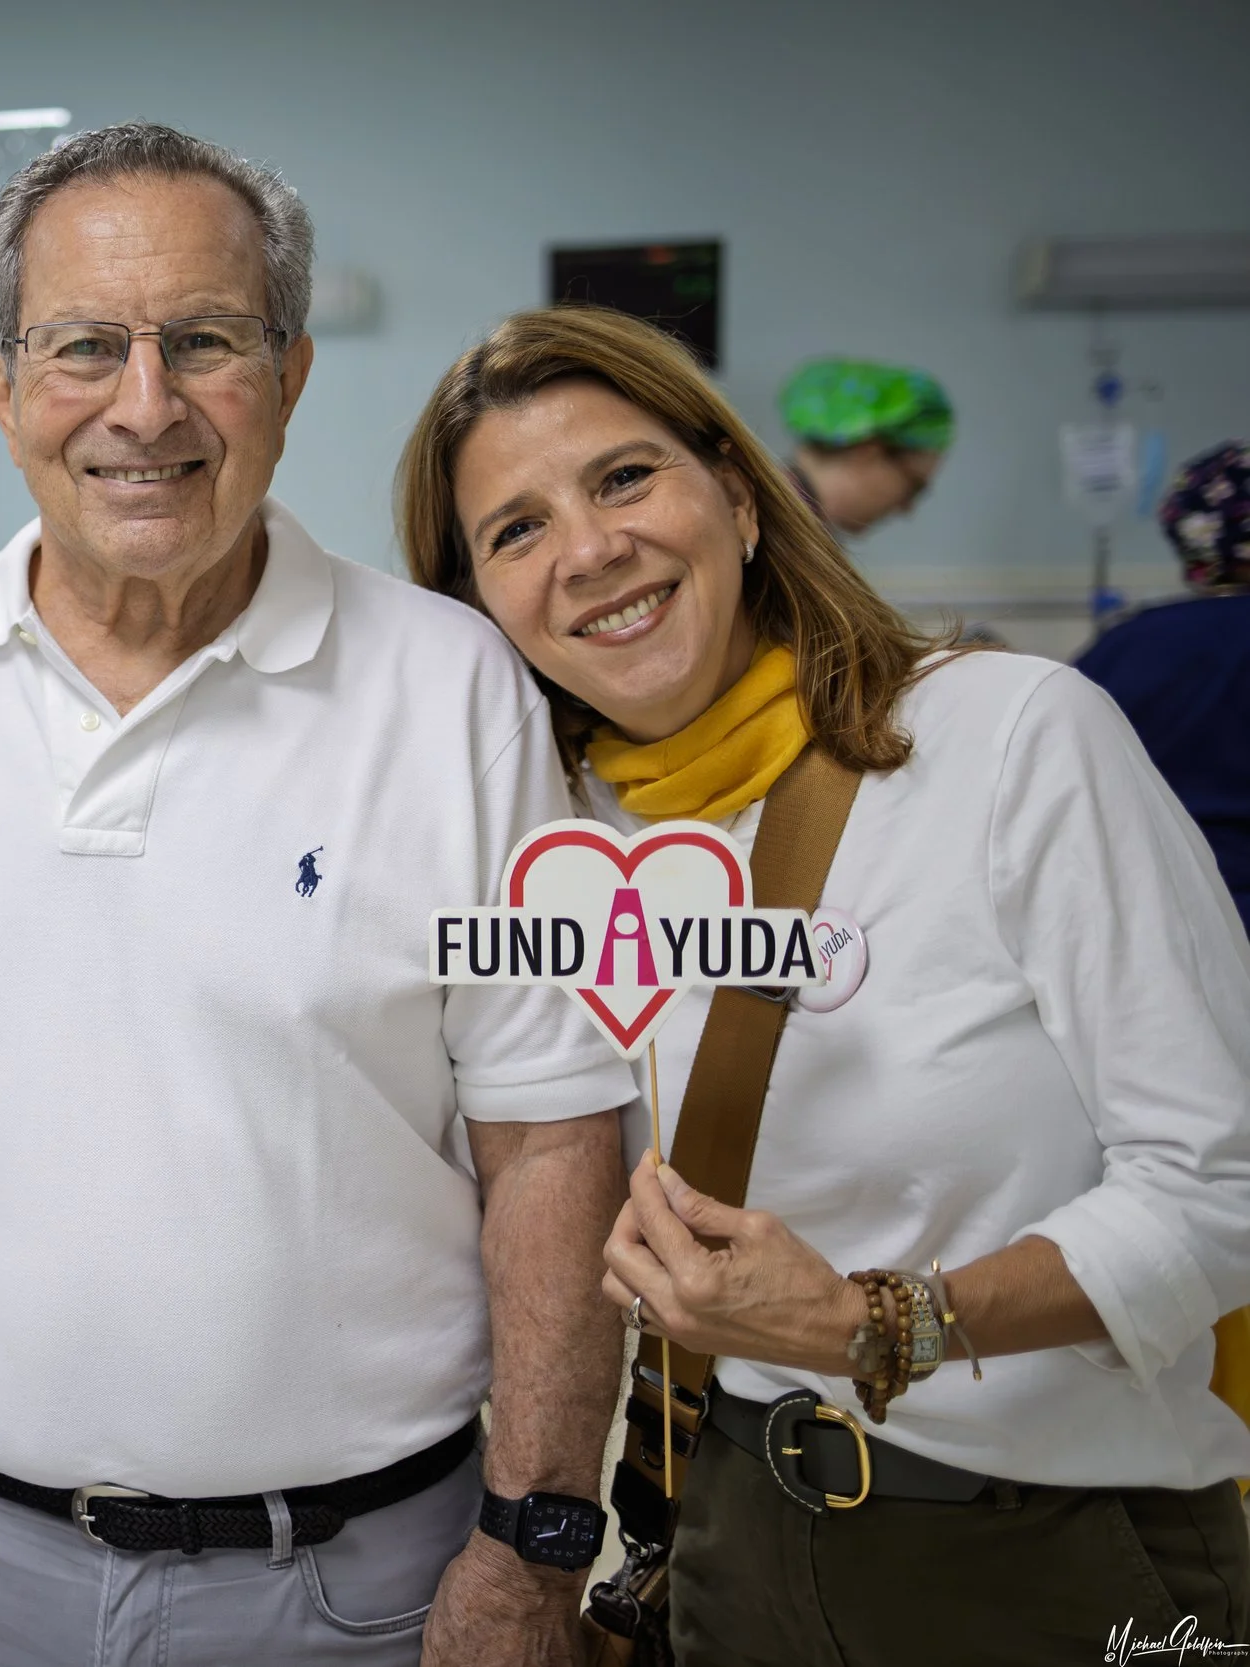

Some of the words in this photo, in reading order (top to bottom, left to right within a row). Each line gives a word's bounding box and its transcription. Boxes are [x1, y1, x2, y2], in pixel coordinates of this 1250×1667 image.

[437, 888, 817, 986] FUNDAYUDA
[571, 1511, 580, 1521] 10
[582, 1517, 591, 1526] 11
[580, 1532, 588, 1542] 12
